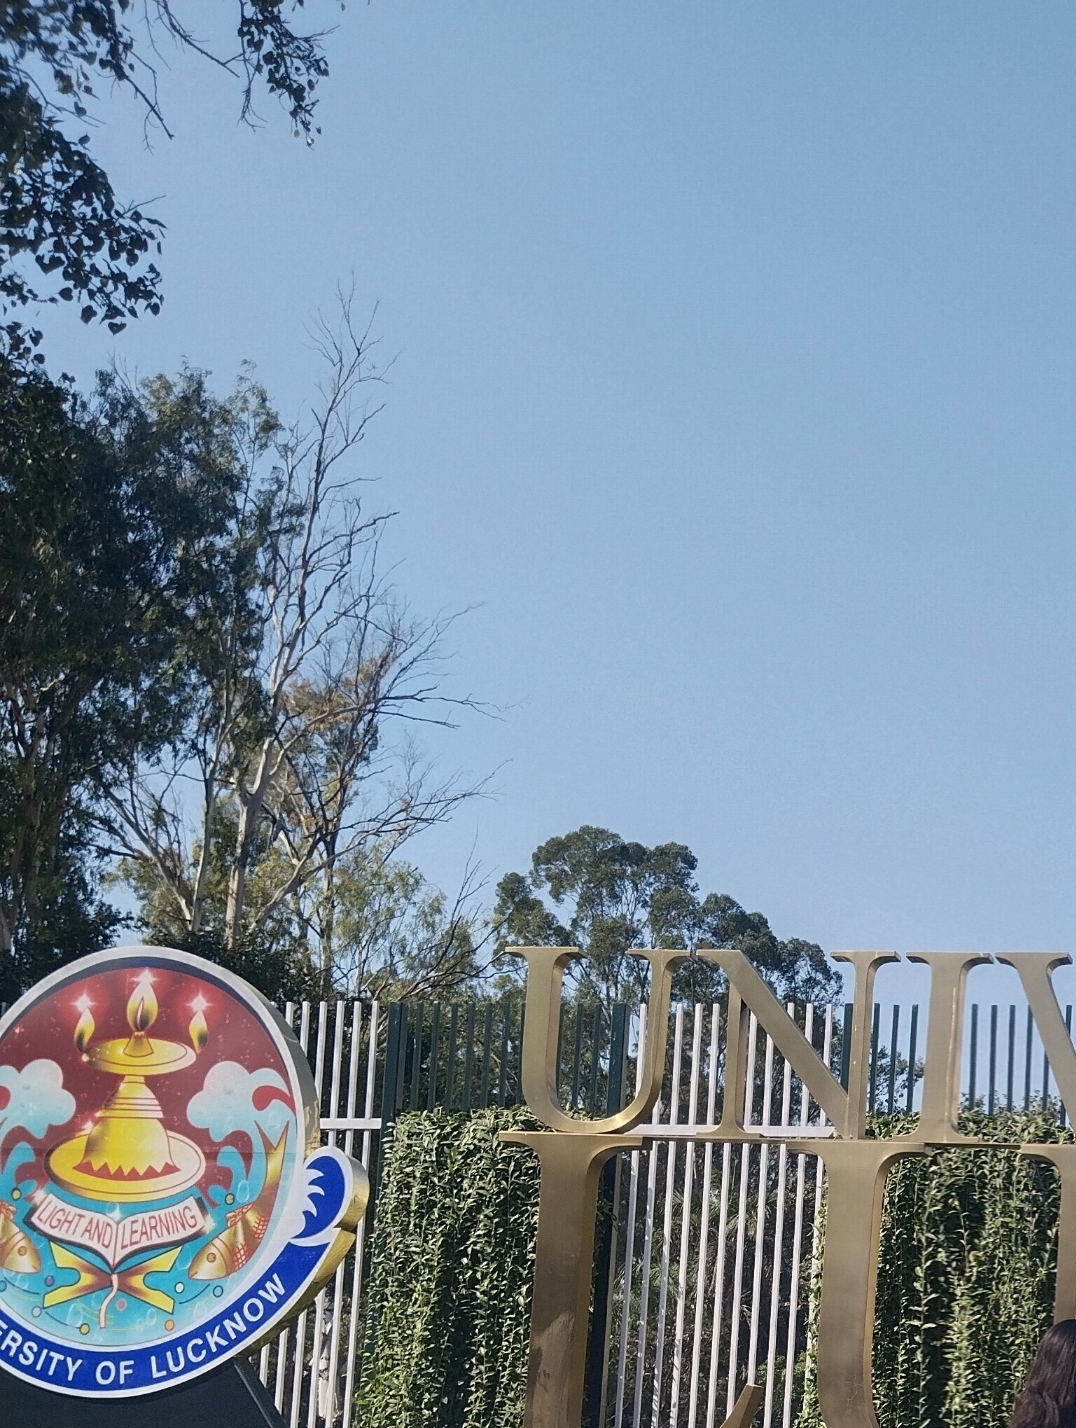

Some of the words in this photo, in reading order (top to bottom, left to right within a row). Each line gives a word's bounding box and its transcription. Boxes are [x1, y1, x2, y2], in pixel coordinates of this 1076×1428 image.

[36, 1202, 86, 1235] LIGHT
[81, 1219, 113, 1249] AND
[121, 1205, 198, 1250] LEARNING
[95, 1359, 135, 1385] OF
[150, 1272, 287, 1380] LUCKNOW
